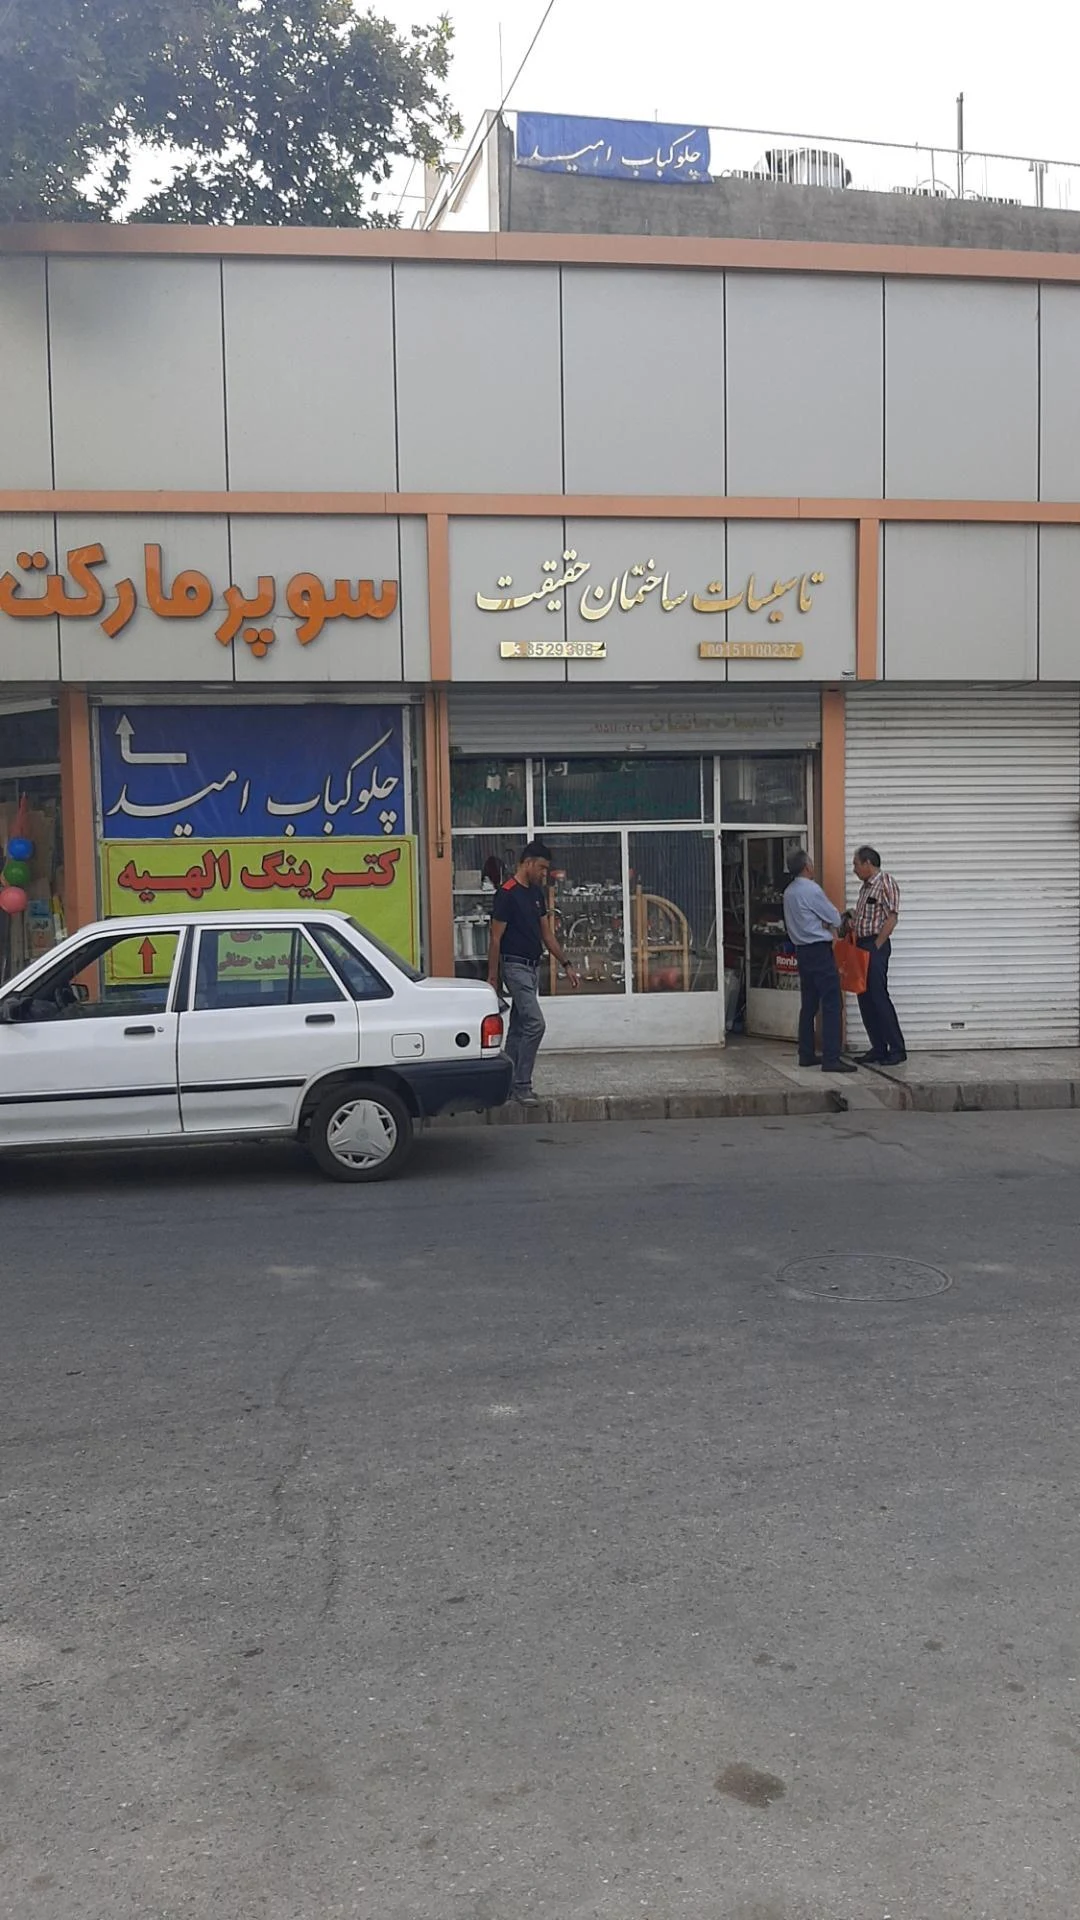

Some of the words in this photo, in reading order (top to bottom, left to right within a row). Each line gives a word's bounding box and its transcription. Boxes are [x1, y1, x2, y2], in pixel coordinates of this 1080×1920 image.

[530, 139, 612, 172] امید
[621, 129, 701, 180] چلوکباب
[476, 549, 591, 612] حقیقت
[579, 558, 688, 621] ساختمان
[105, 770, 250, 837] امید
[266, 727, 400, 836] چلوکباب
[117, 848, 232, 902] الهیه
[240, 847, 401, 901] کترینگ
